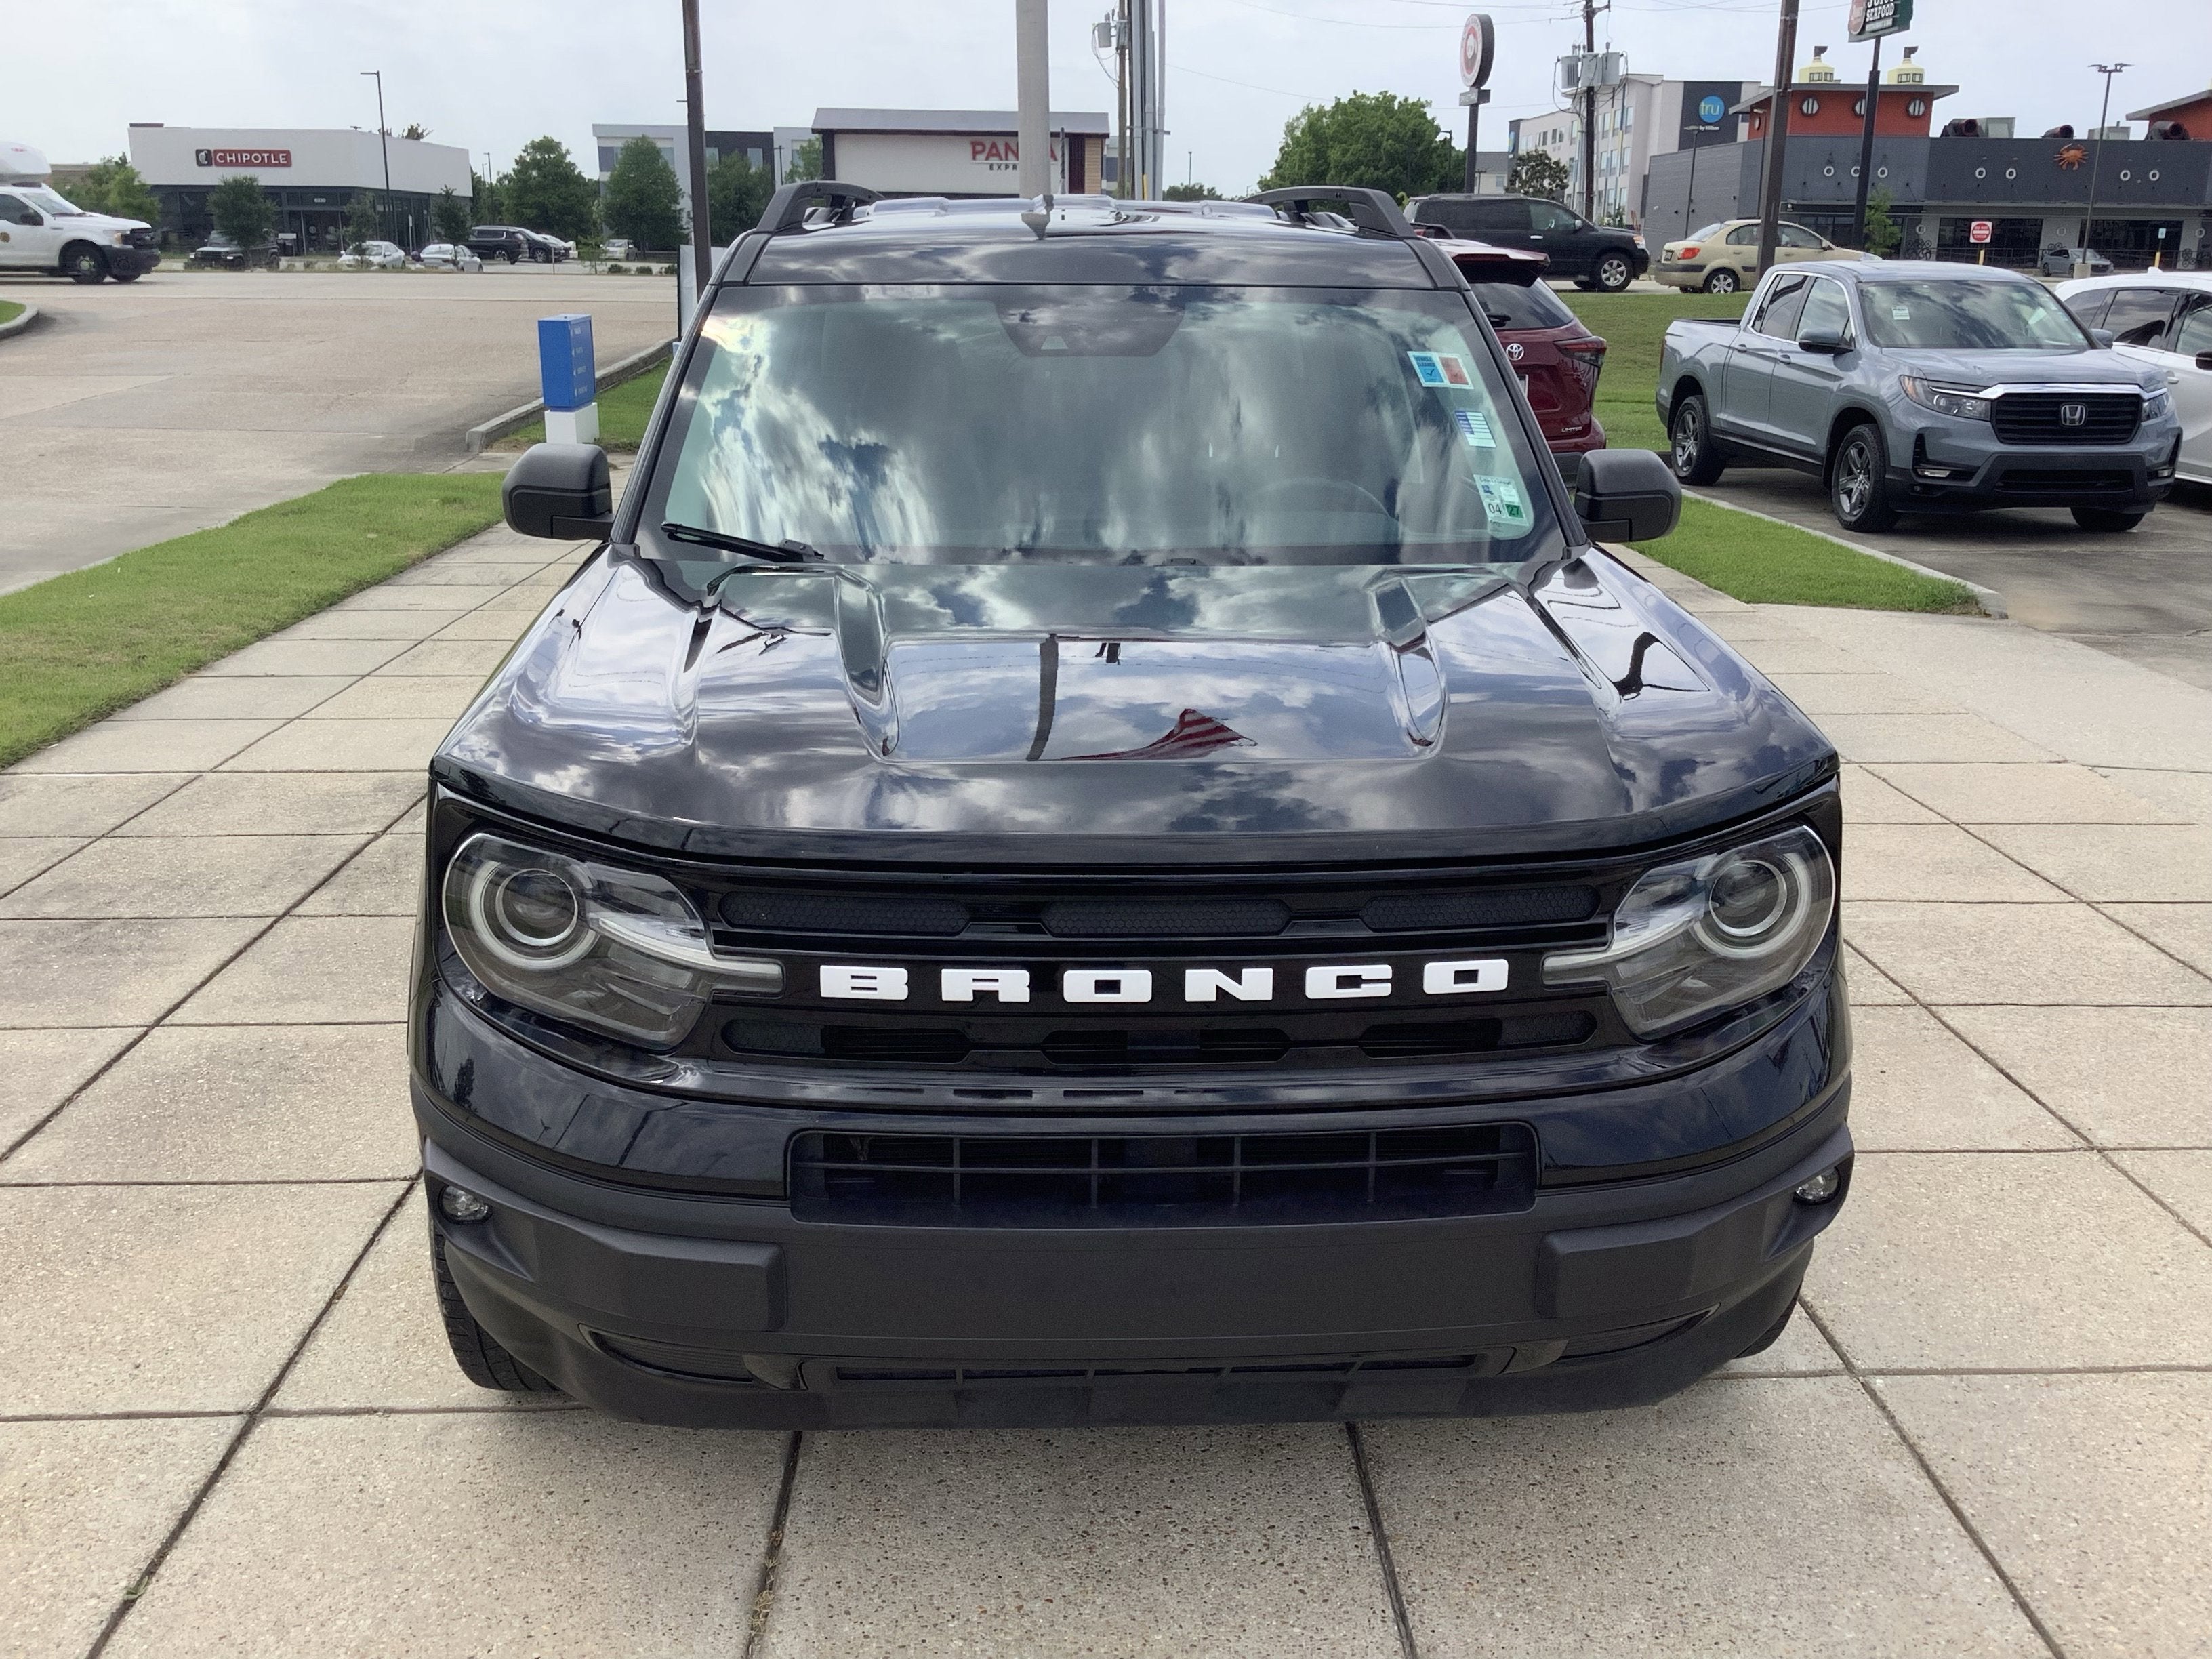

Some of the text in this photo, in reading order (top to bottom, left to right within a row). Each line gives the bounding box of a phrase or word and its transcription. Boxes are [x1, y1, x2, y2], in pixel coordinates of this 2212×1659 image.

[1866, 3, 1895, 22] SEAFOOD
[1700, 102, 1720, 115] tru
[216, 152, 287, 164] CHIPOTLE
[1488, 503, 1520, 516] 04 27
[819, 958, 1509, 1004] BRONCO
